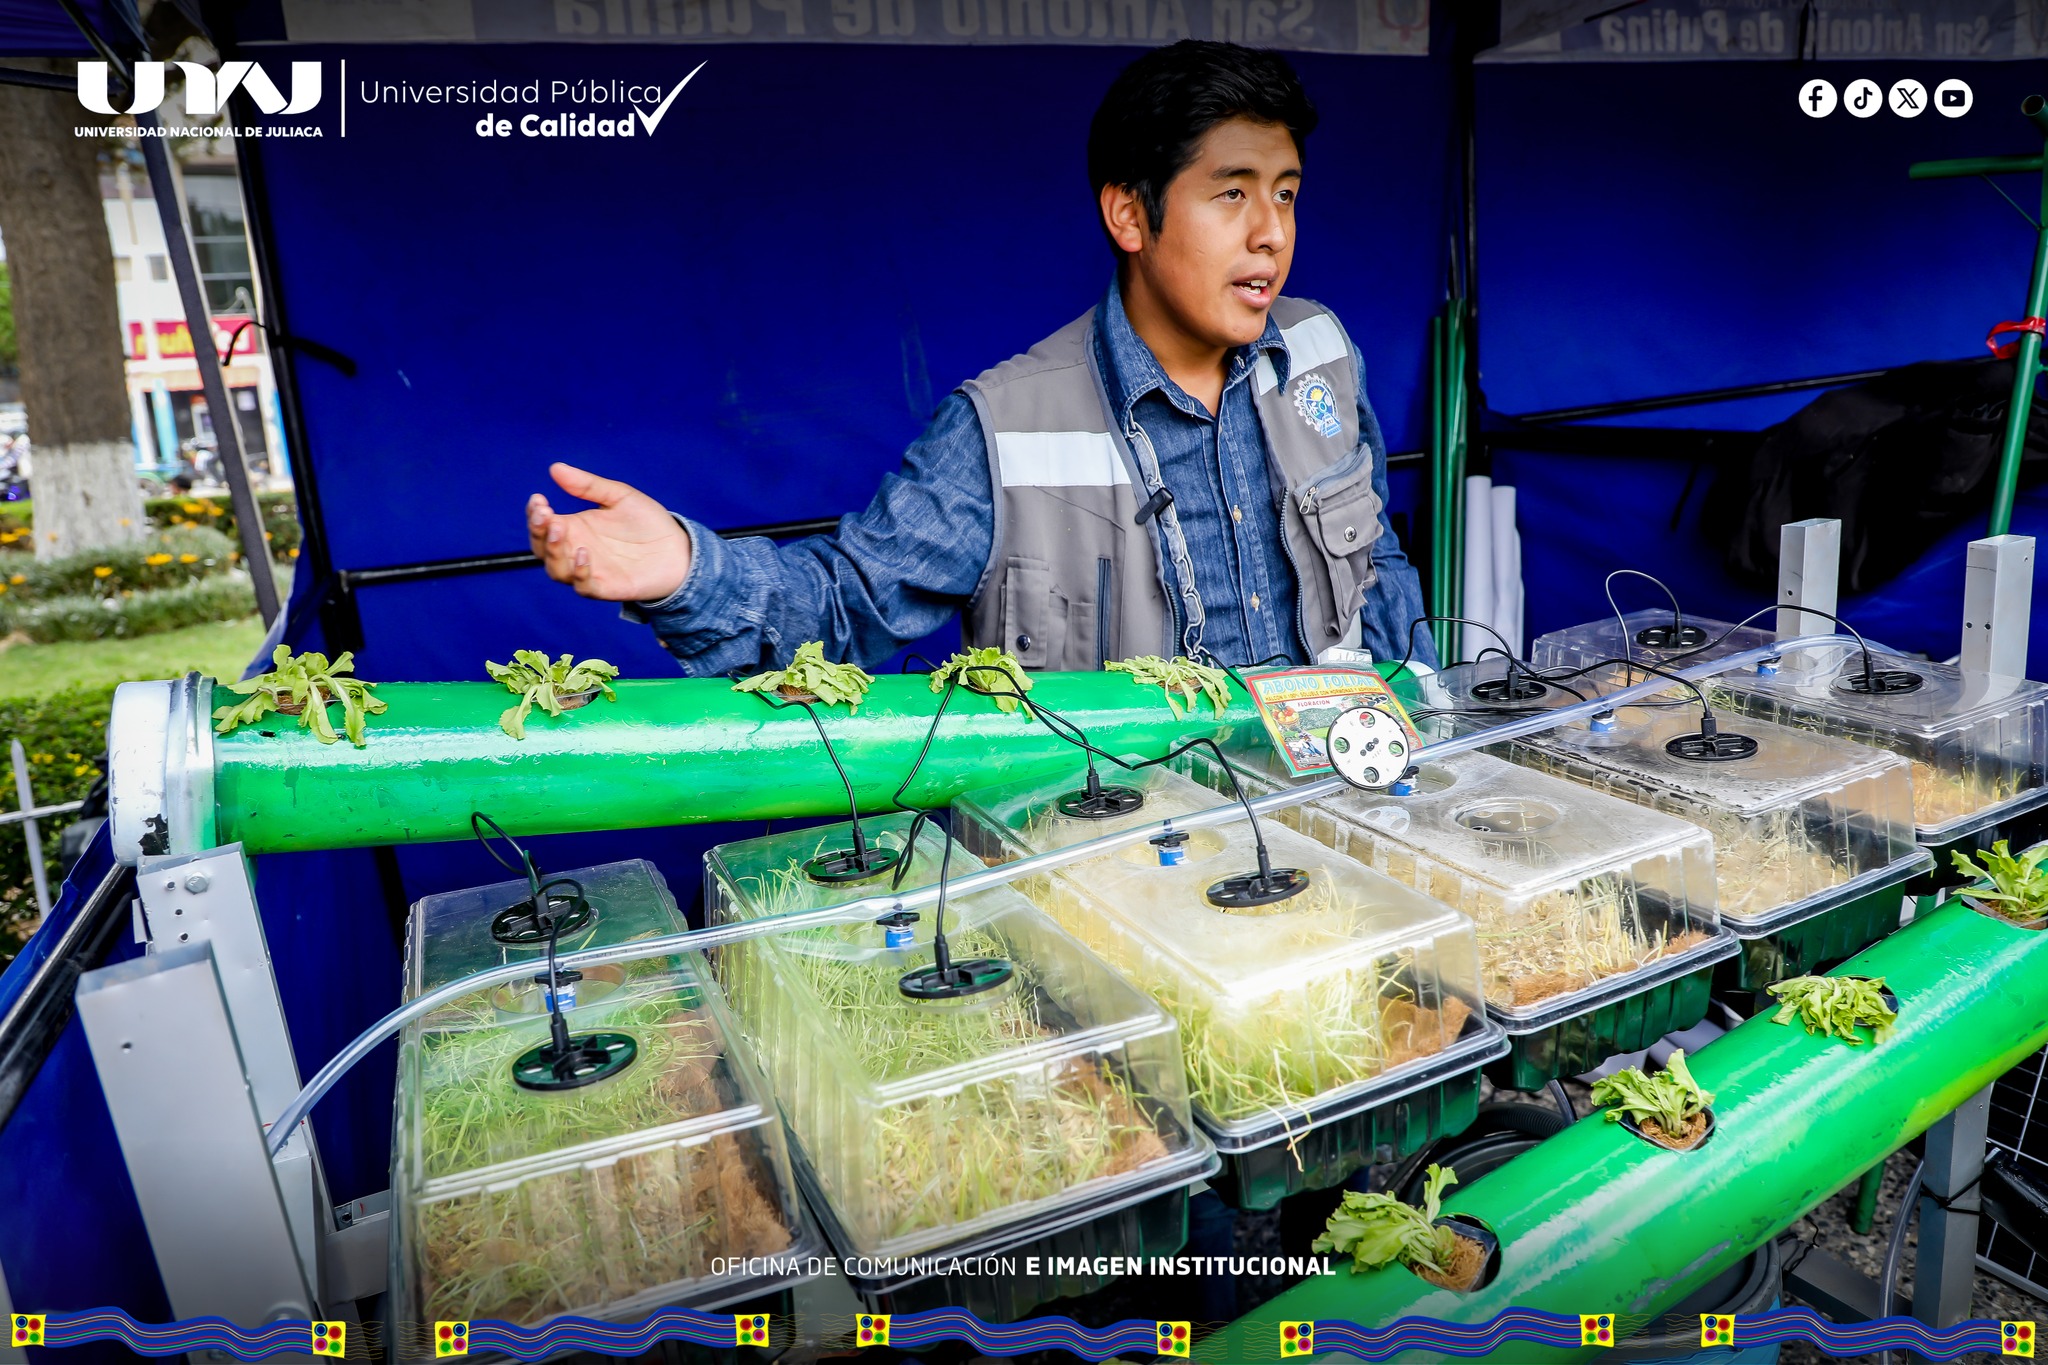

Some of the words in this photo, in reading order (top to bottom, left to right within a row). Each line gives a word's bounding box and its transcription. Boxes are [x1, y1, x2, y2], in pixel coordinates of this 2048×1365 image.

[1262, 677, 1318, 694] ABONO
[1322, 675, 1378, 688] FOLIAR
[1297, 699, 1331, 708] FLORACION
